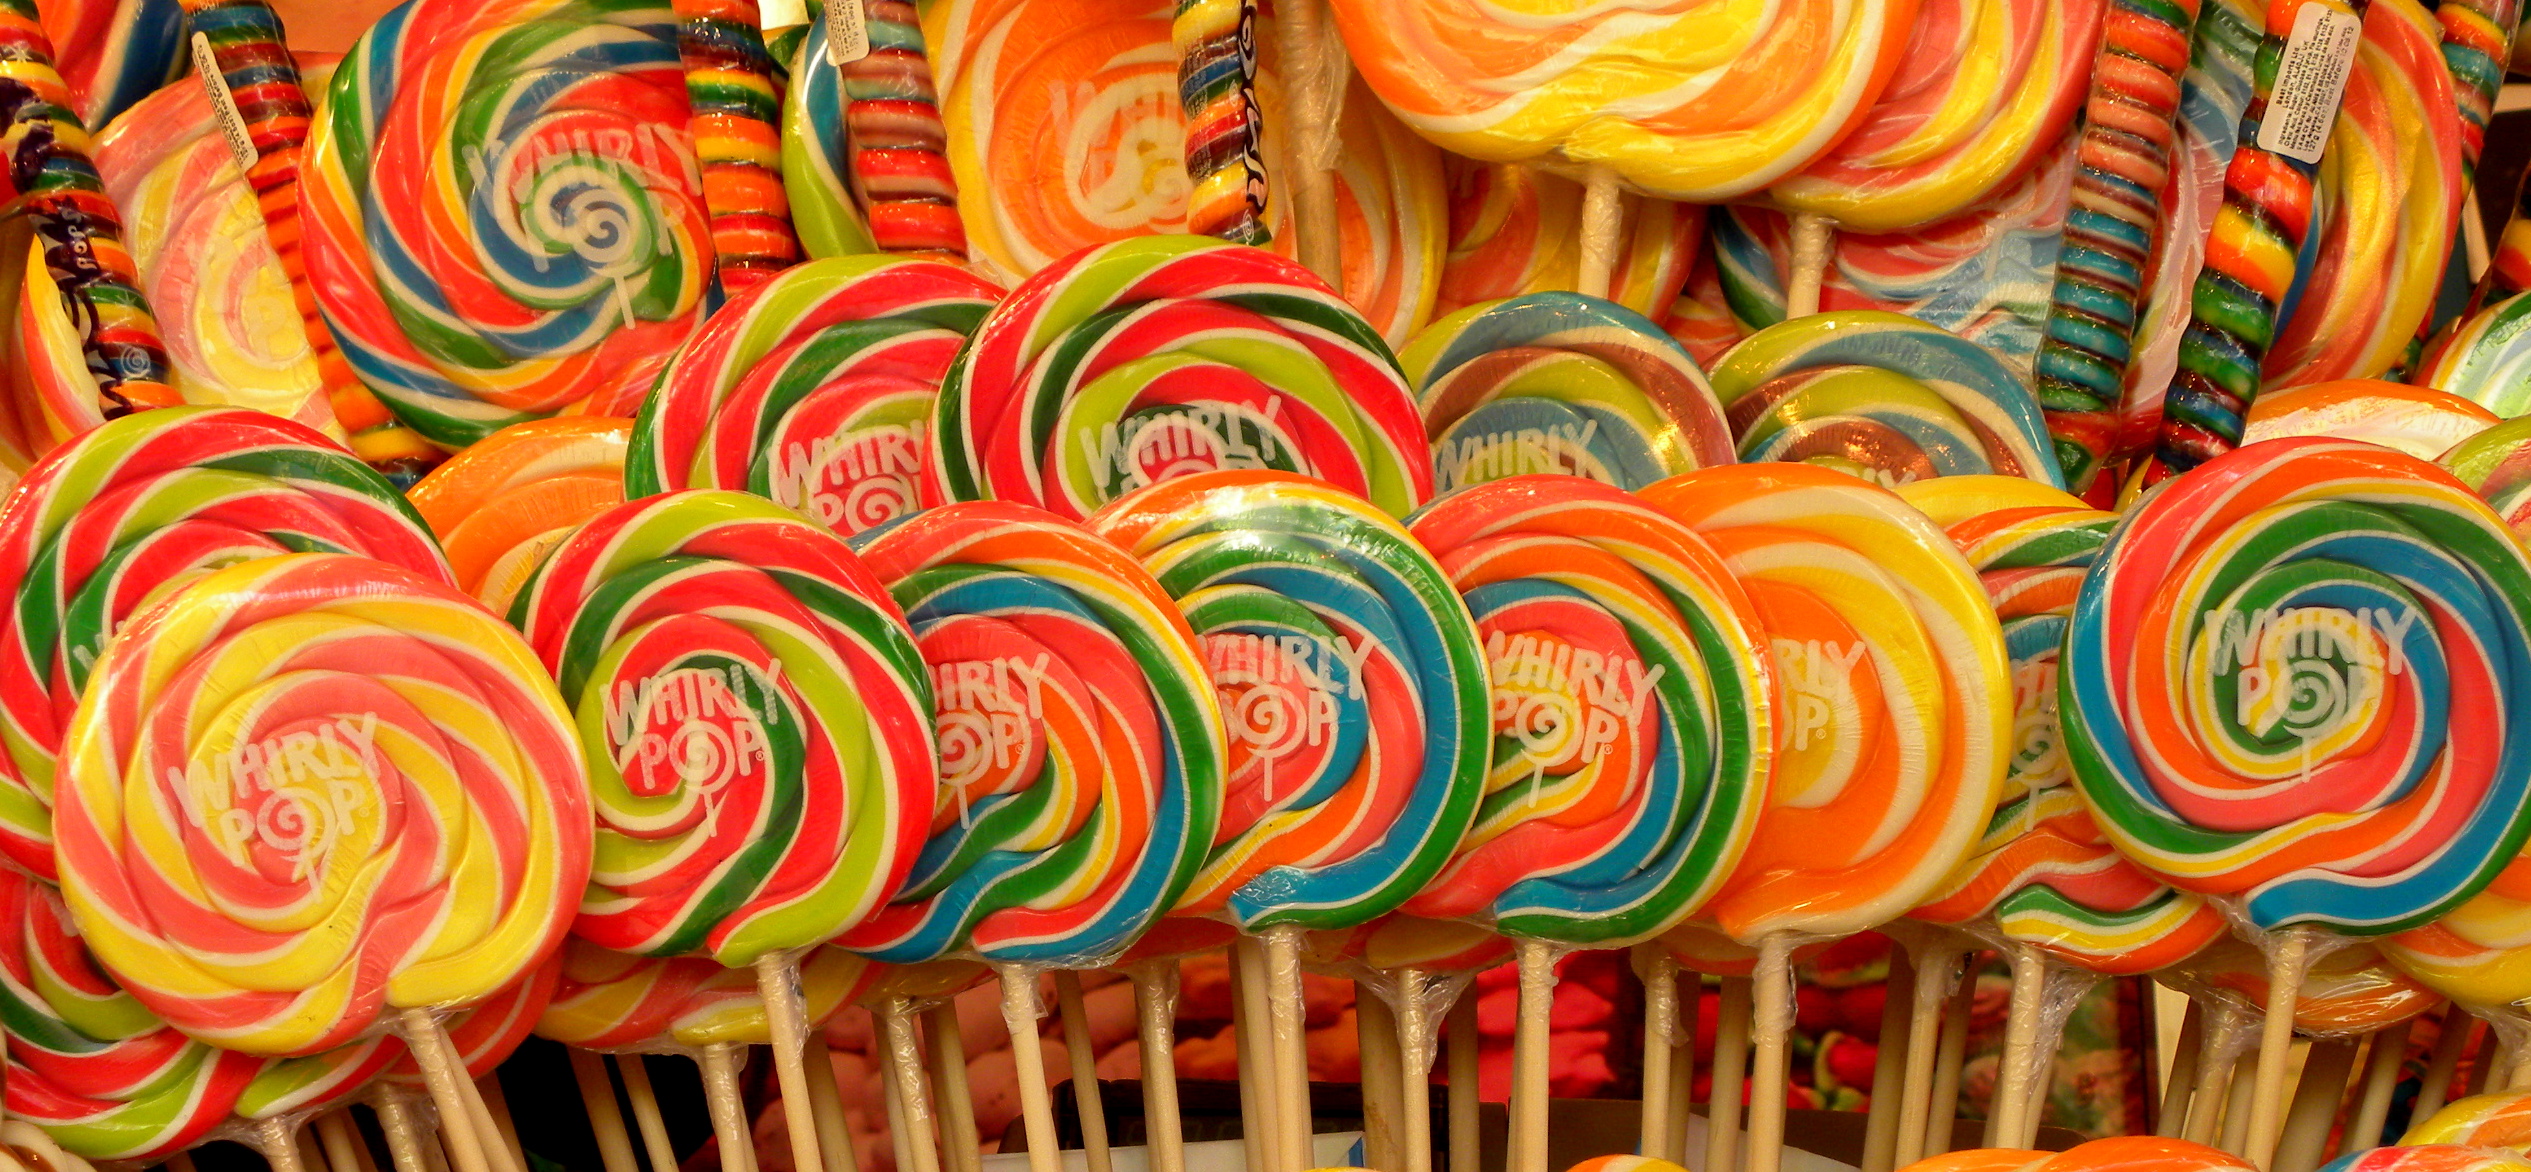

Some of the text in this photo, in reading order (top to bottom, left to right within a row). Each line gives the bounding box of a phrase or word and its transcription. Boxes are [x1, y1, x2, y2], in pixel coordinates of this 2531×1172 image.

[1079, 394, 1282, 488] WHIRLY
[1432, 418, 1598, 496] WHIRLY
[813, 472, 923, 534] PO
[2203, 606, 2417, 676] WHIRLY
[599, 657, 782, 747] WHIRLY
[166, 711, 382, 828] WHIRLY
[936, 708, 1030, 787] OP
